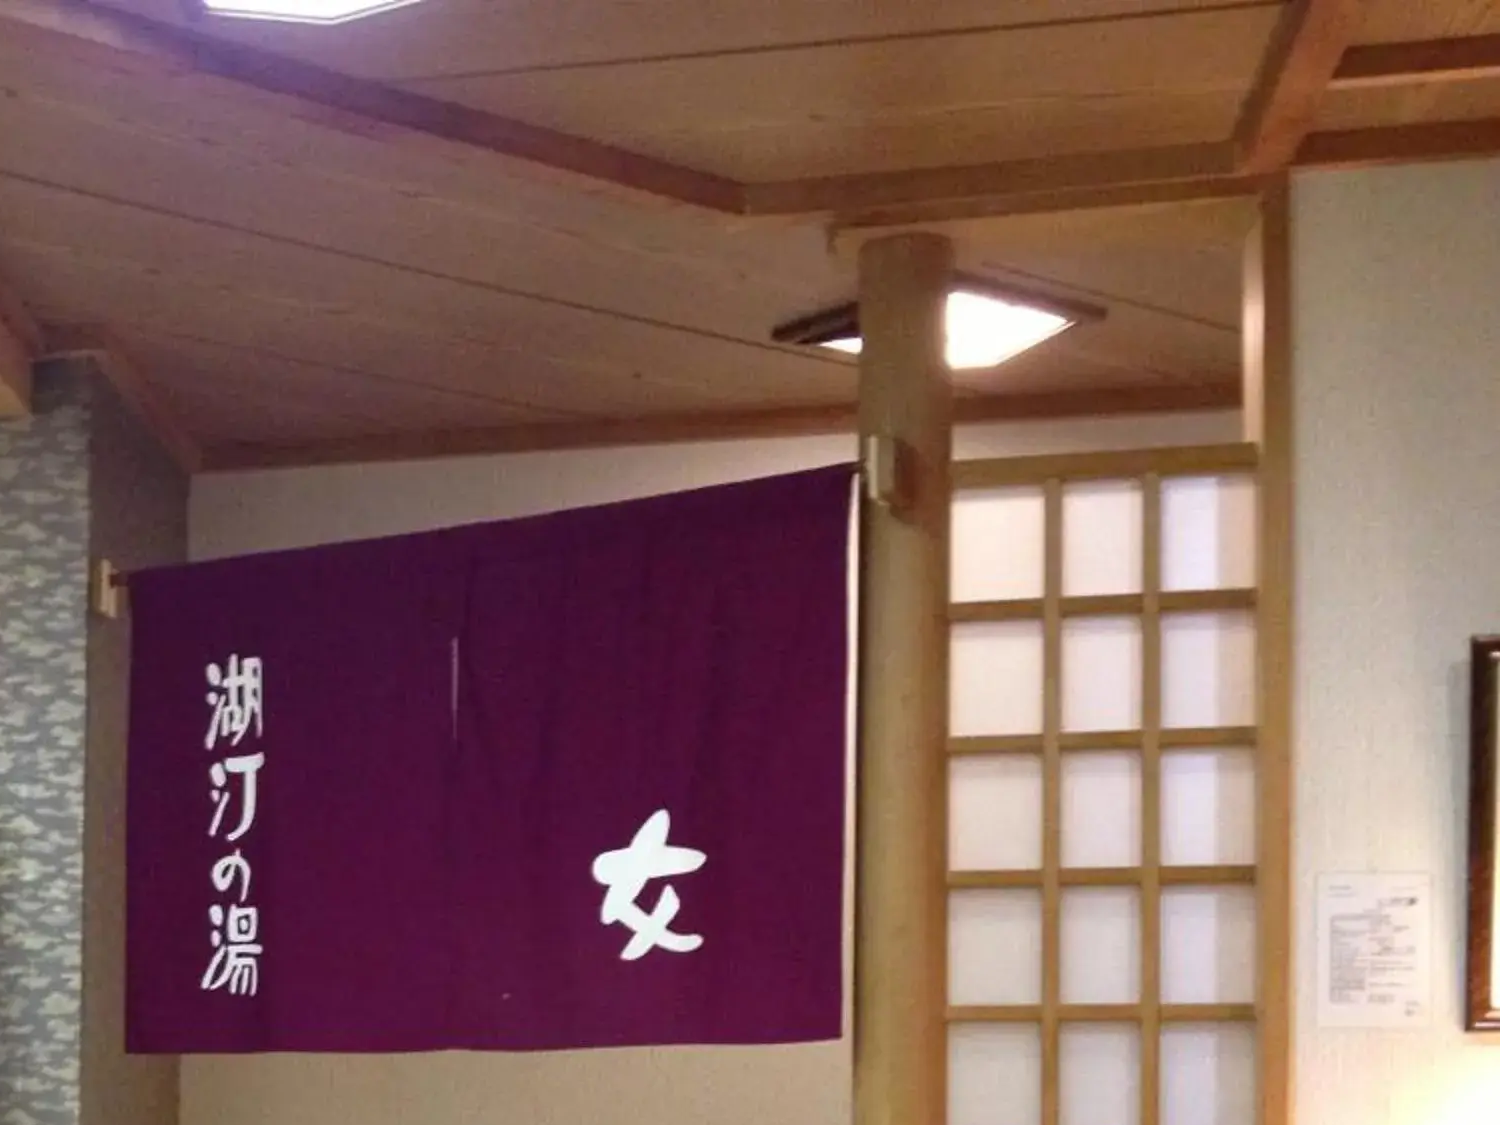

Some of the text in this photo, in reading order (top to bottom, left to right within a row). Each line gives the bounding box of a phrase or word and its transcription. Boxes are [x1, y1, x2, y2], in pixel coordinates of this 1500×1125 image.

[200, 653, 265, 997] 湖汀の湯
[591, 808, 708, 962] 女
